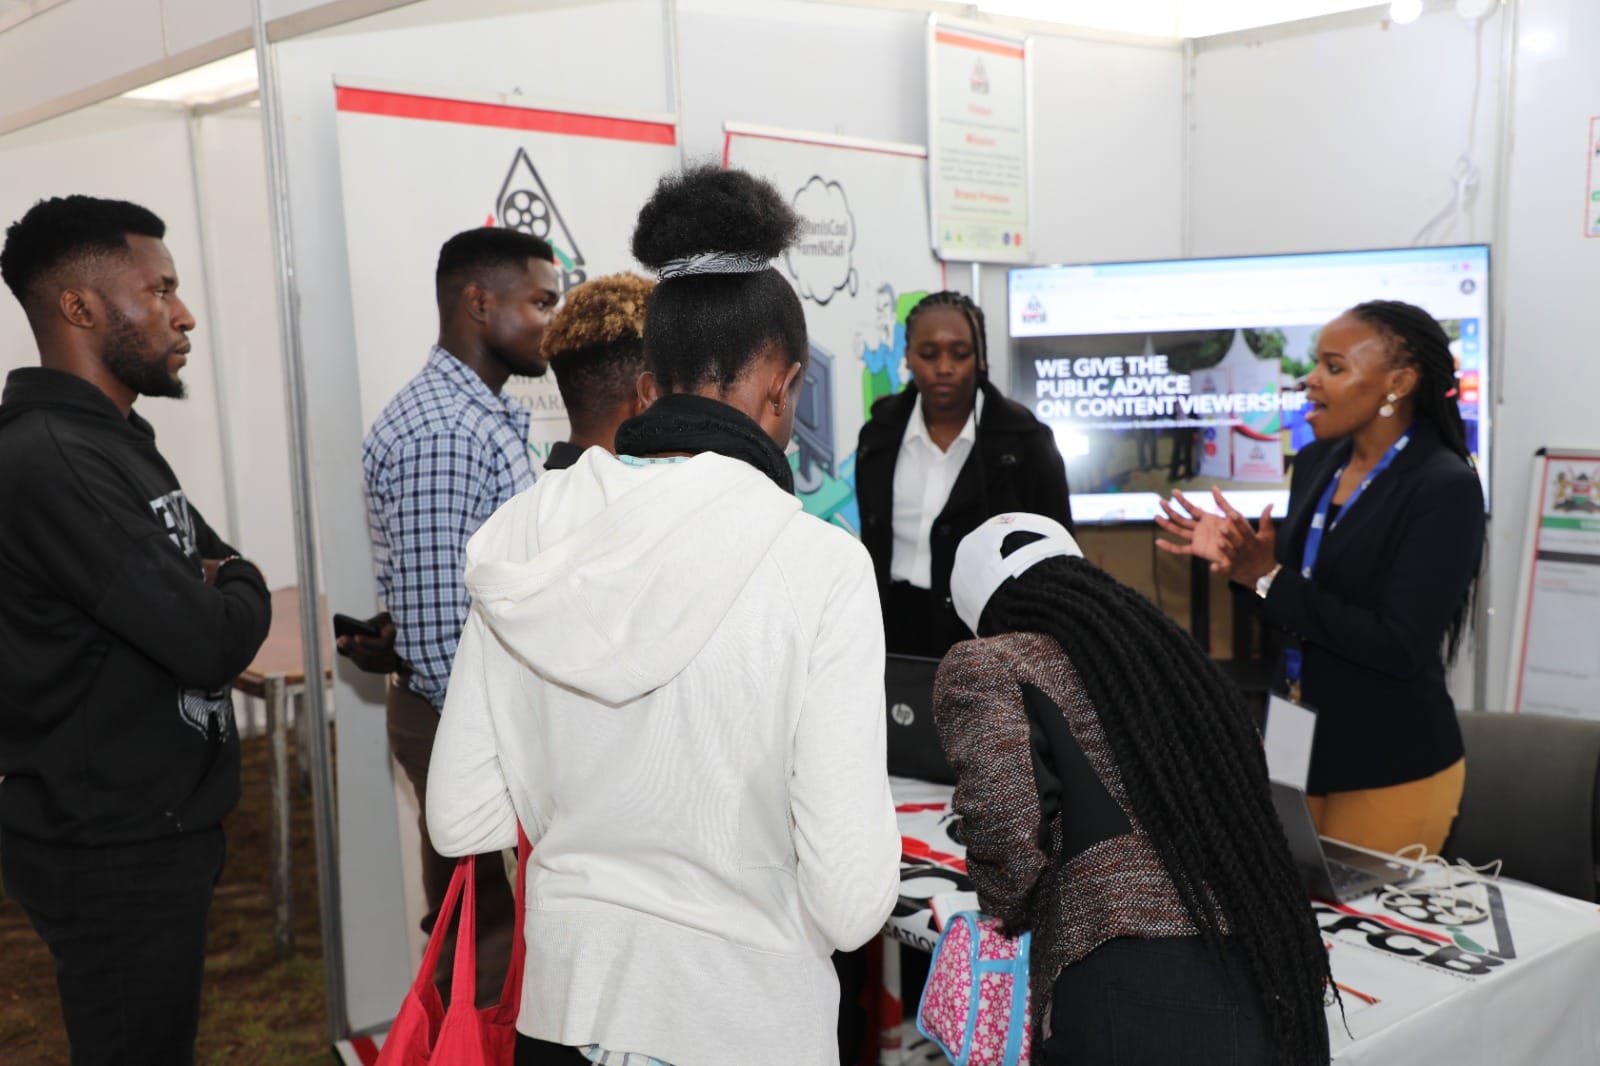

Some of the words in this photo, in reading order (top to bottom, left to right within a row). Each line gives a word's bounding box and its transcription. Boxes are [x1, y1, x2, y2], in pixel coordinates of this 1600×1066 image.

[1035, 359, 1070, 378] WE
[1074, 357, 1123, 377] GIVE
[1125, 355, 1168, 375] THE
[1036, 378, 1109, 398] PUBLIC
[1111, 374, 1191, 395] ADVICE
[1036, 399, 1070, 419] ON
[1075, 395, 1177, 416] CONTENT
